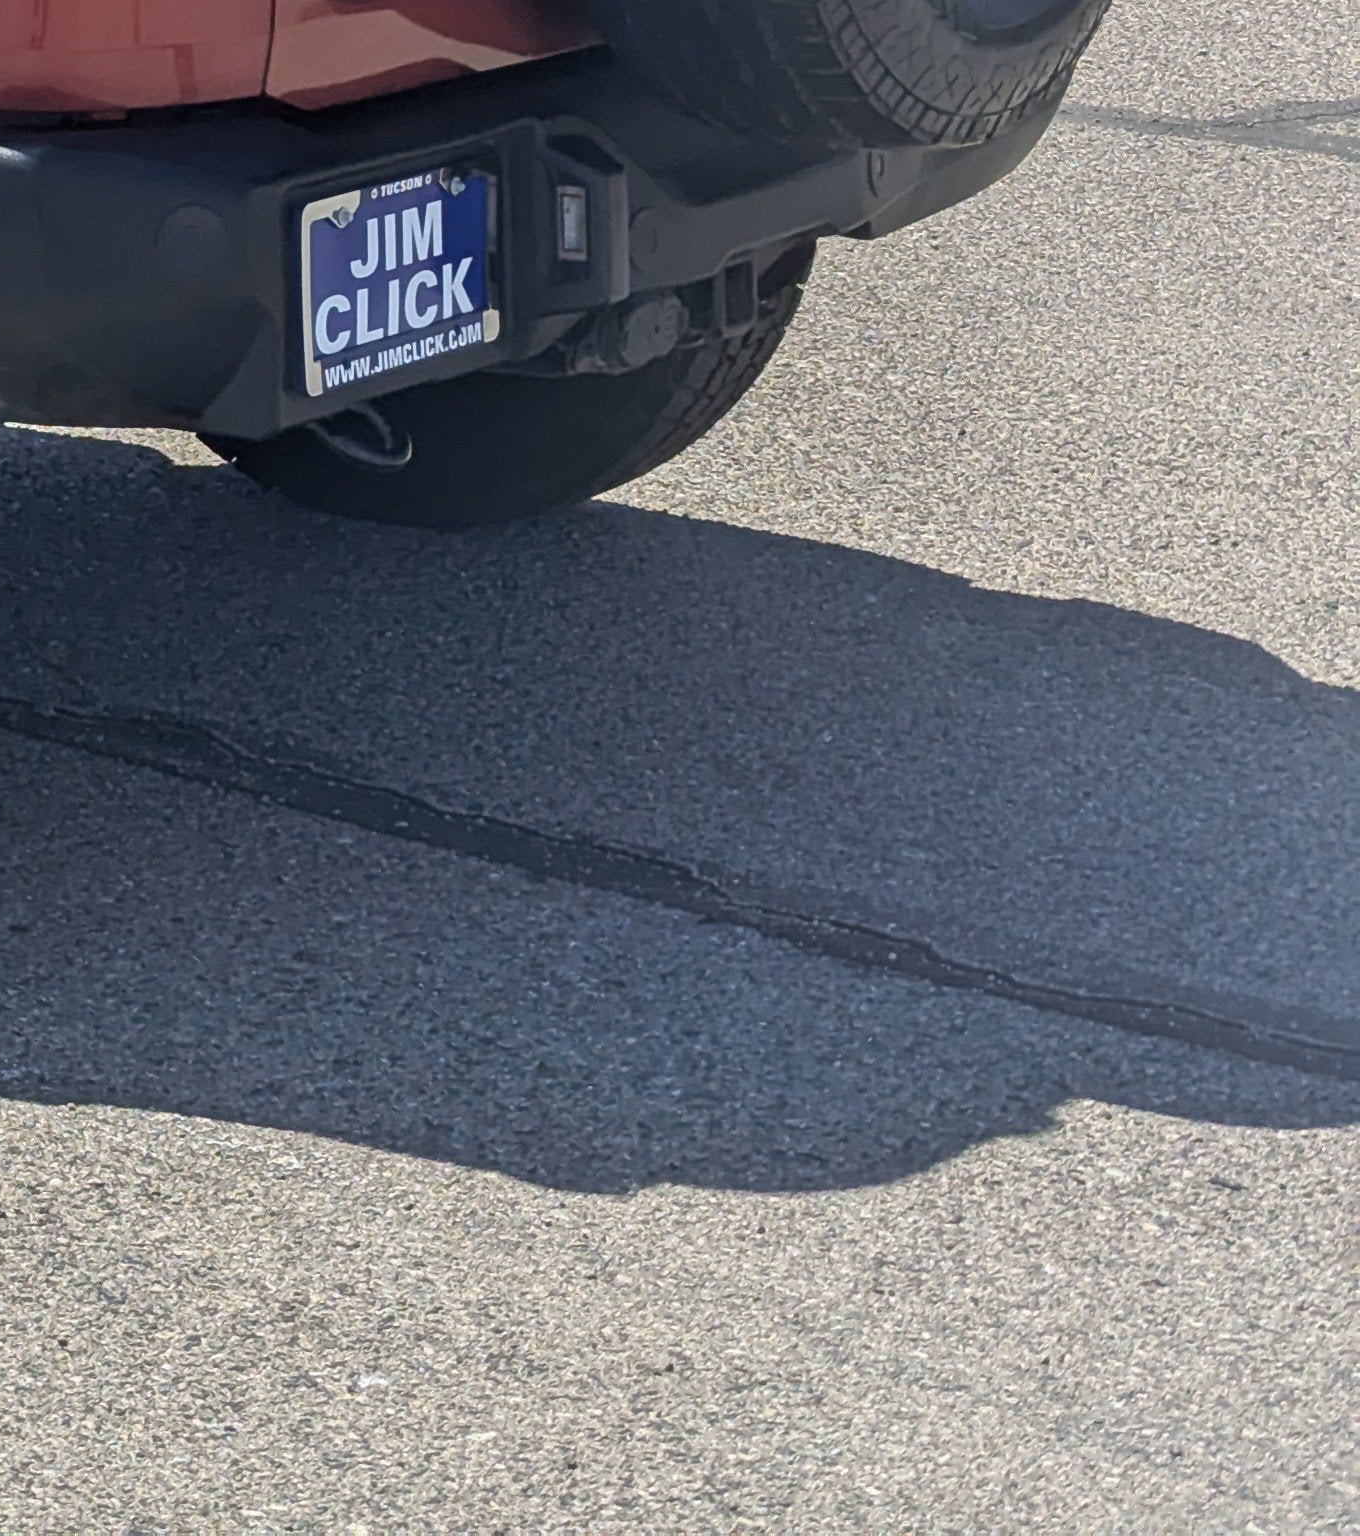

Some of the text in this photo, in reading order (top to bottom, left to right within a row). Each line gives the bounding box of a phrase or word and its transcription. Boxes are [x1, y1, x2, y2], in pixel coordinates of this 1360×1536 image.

[380, 175, 423, 197] TUCSON
[350, 199, 443, 279] JIM
[314, 256, 475, 355] CLICK
